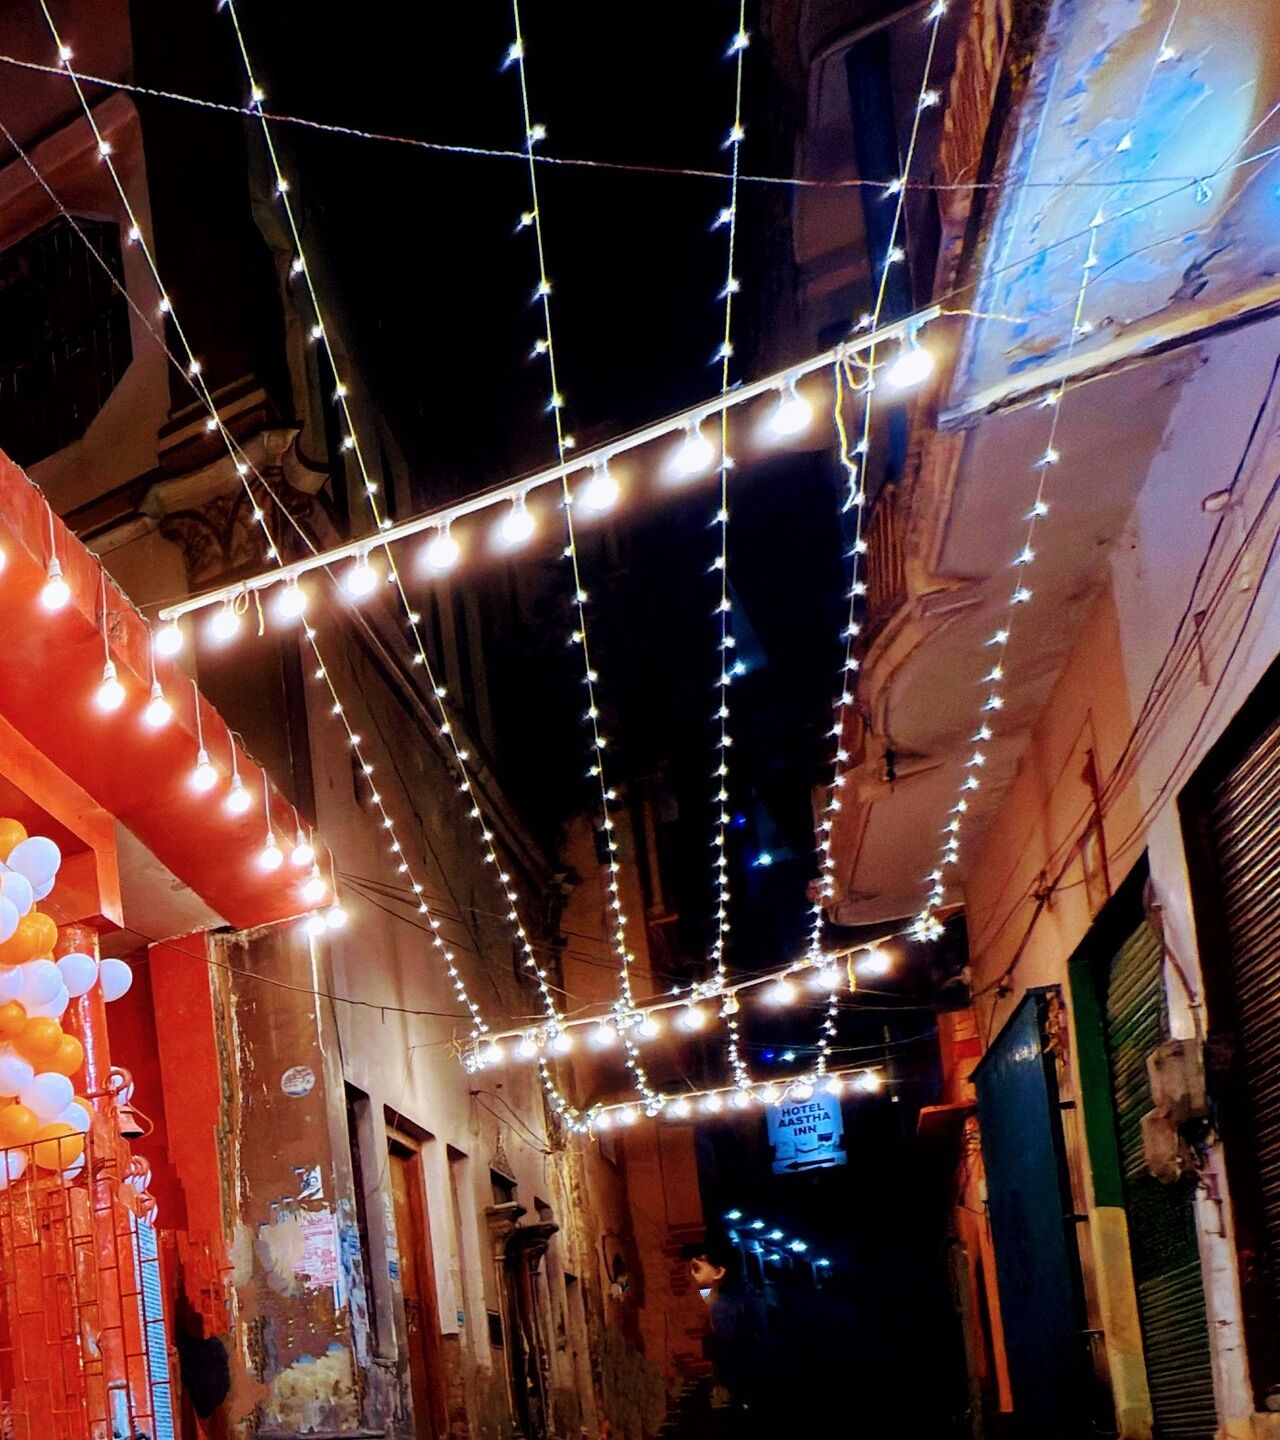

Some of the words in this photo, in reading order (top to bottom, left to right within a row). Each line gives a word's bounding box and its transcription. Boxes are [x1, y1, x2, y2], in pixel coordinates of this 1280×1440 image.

[782, 1103, 825, 1118] HOTEL
[779, 1112, 831, 1128] AASTHA
[793, 1125, 817, 1136] INN
